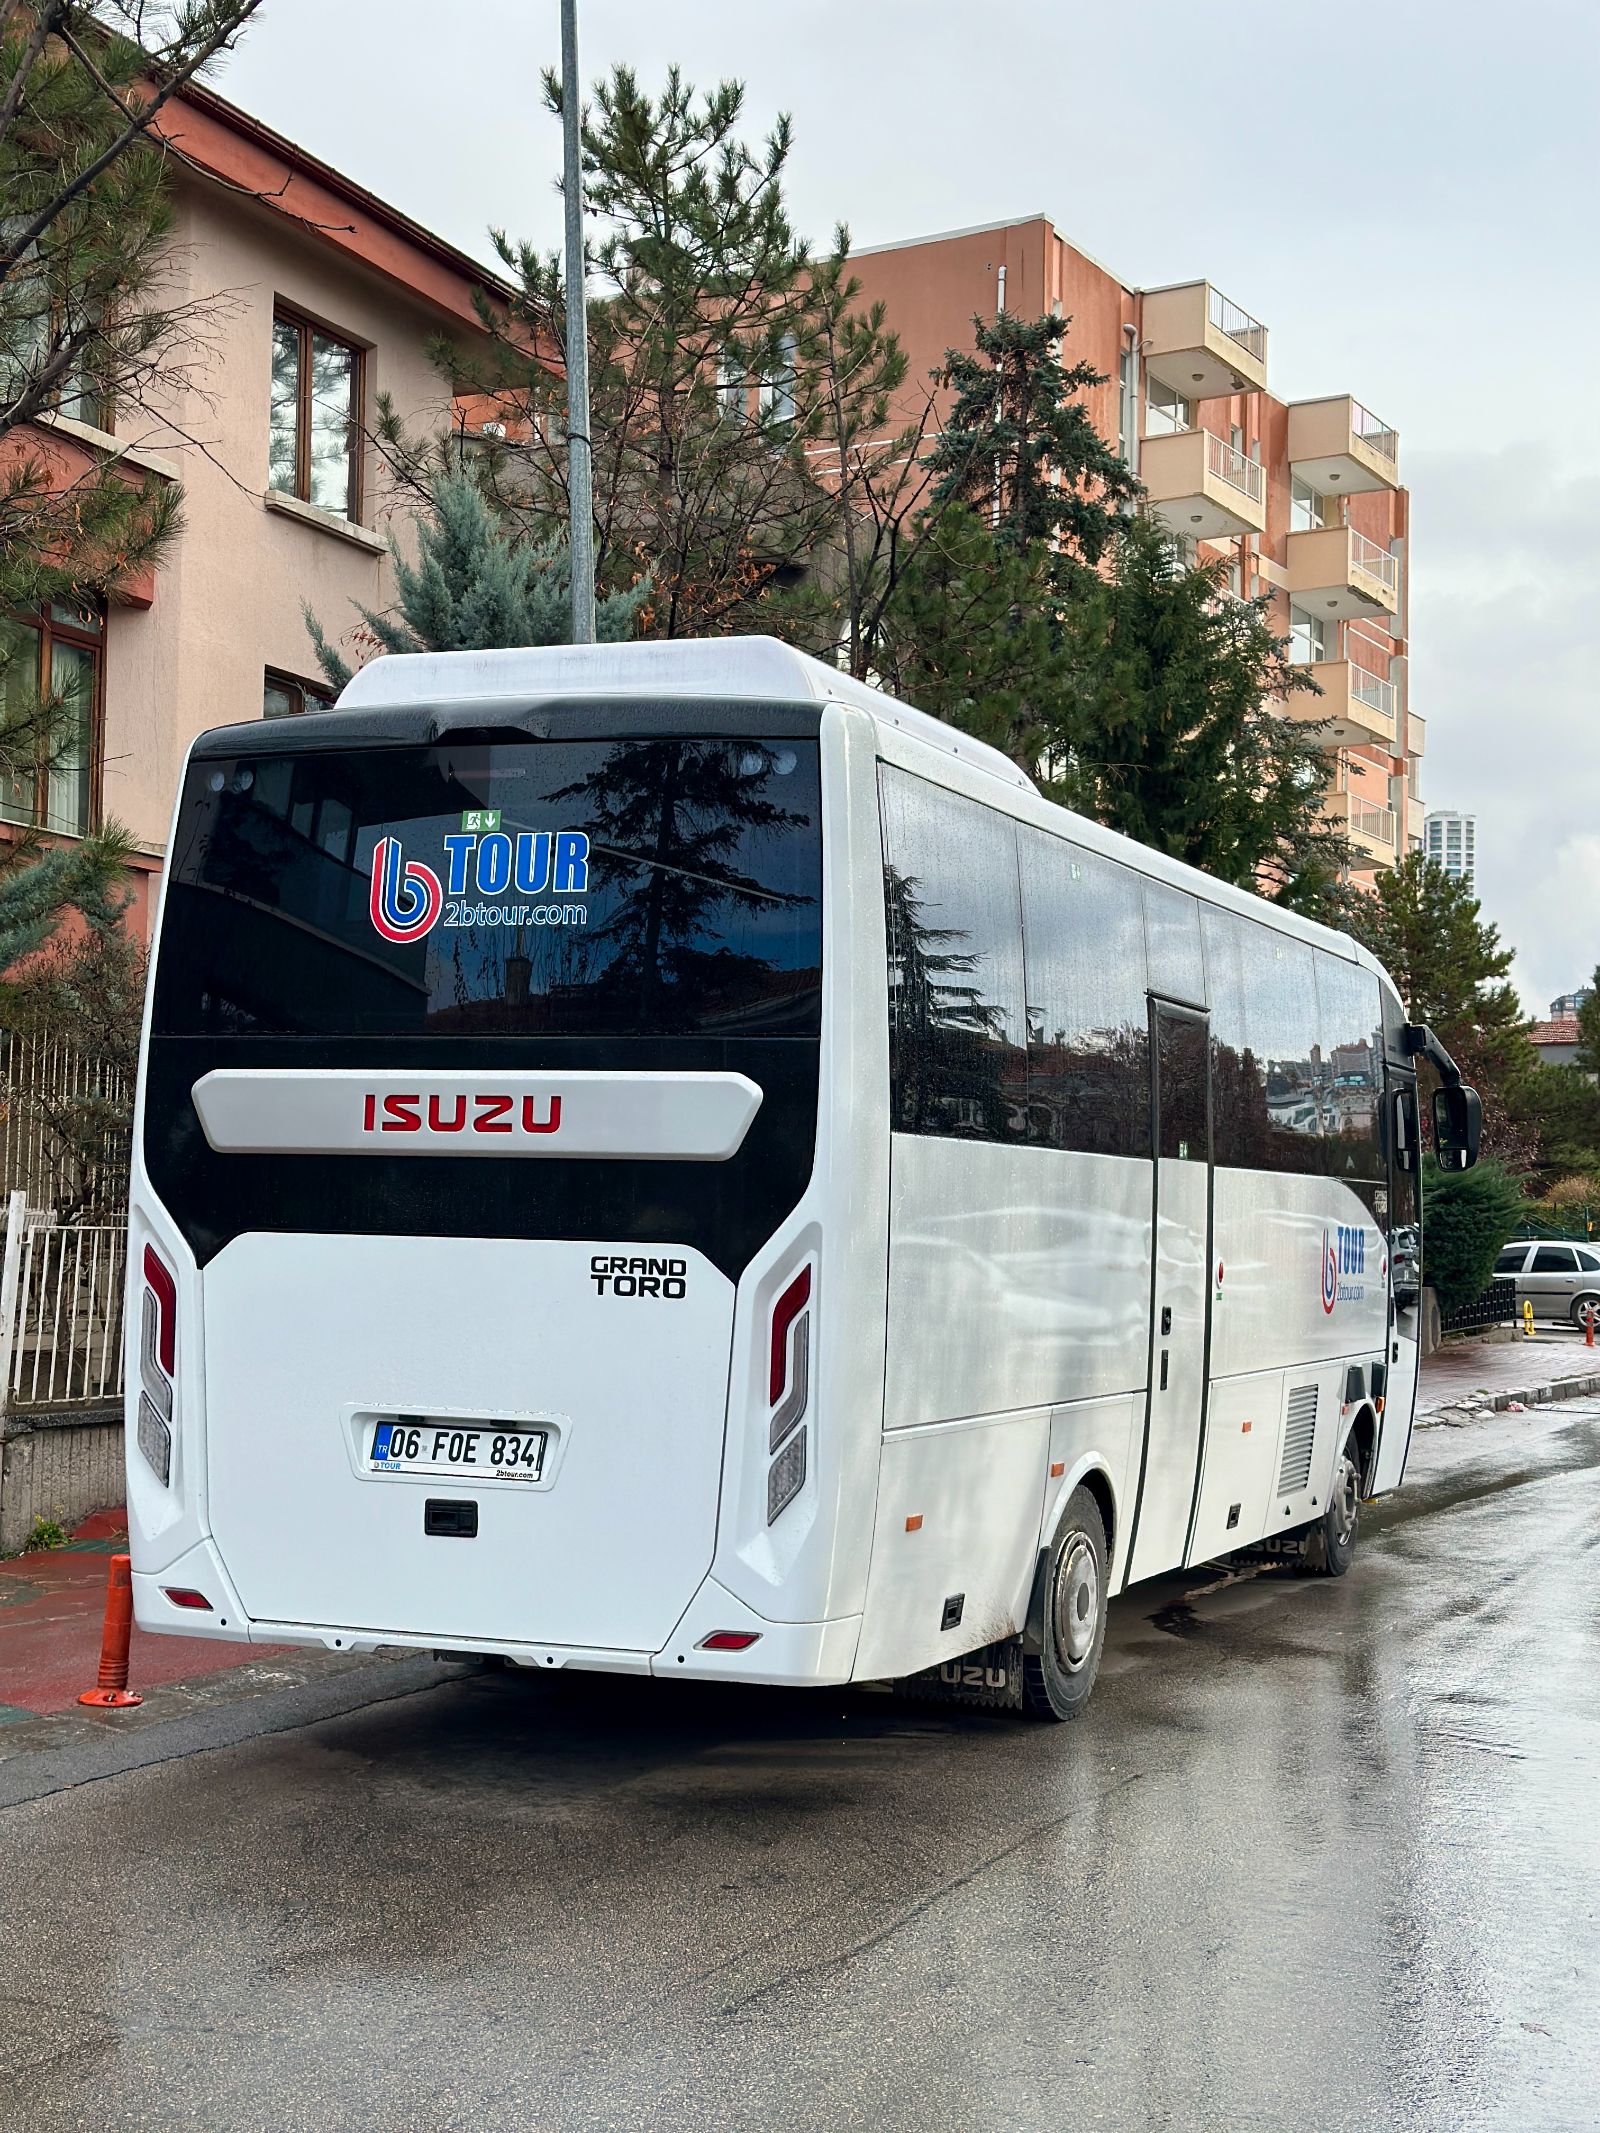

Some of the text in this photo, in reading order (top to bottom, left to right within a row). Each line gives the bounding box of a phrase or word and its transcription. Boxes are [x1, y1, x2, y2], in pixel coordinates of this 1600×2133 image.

[444, 831, 590, 895] TOUR
[444, 900, 587, 926] 2btour.com
[363, 1094, 562, 1133] ISUZU
[1338, 1226, 1365, 1274] TOUR
[591, 1256, 687, 1277] GRAND
[591, 1274, 686, 1299] TORO
[378, 1428, 535, 1467] TR 06 FOE 834
[380, 1462, 401, 1470] TOUR
[496, 1469, 534, 1479] 2btour.com
